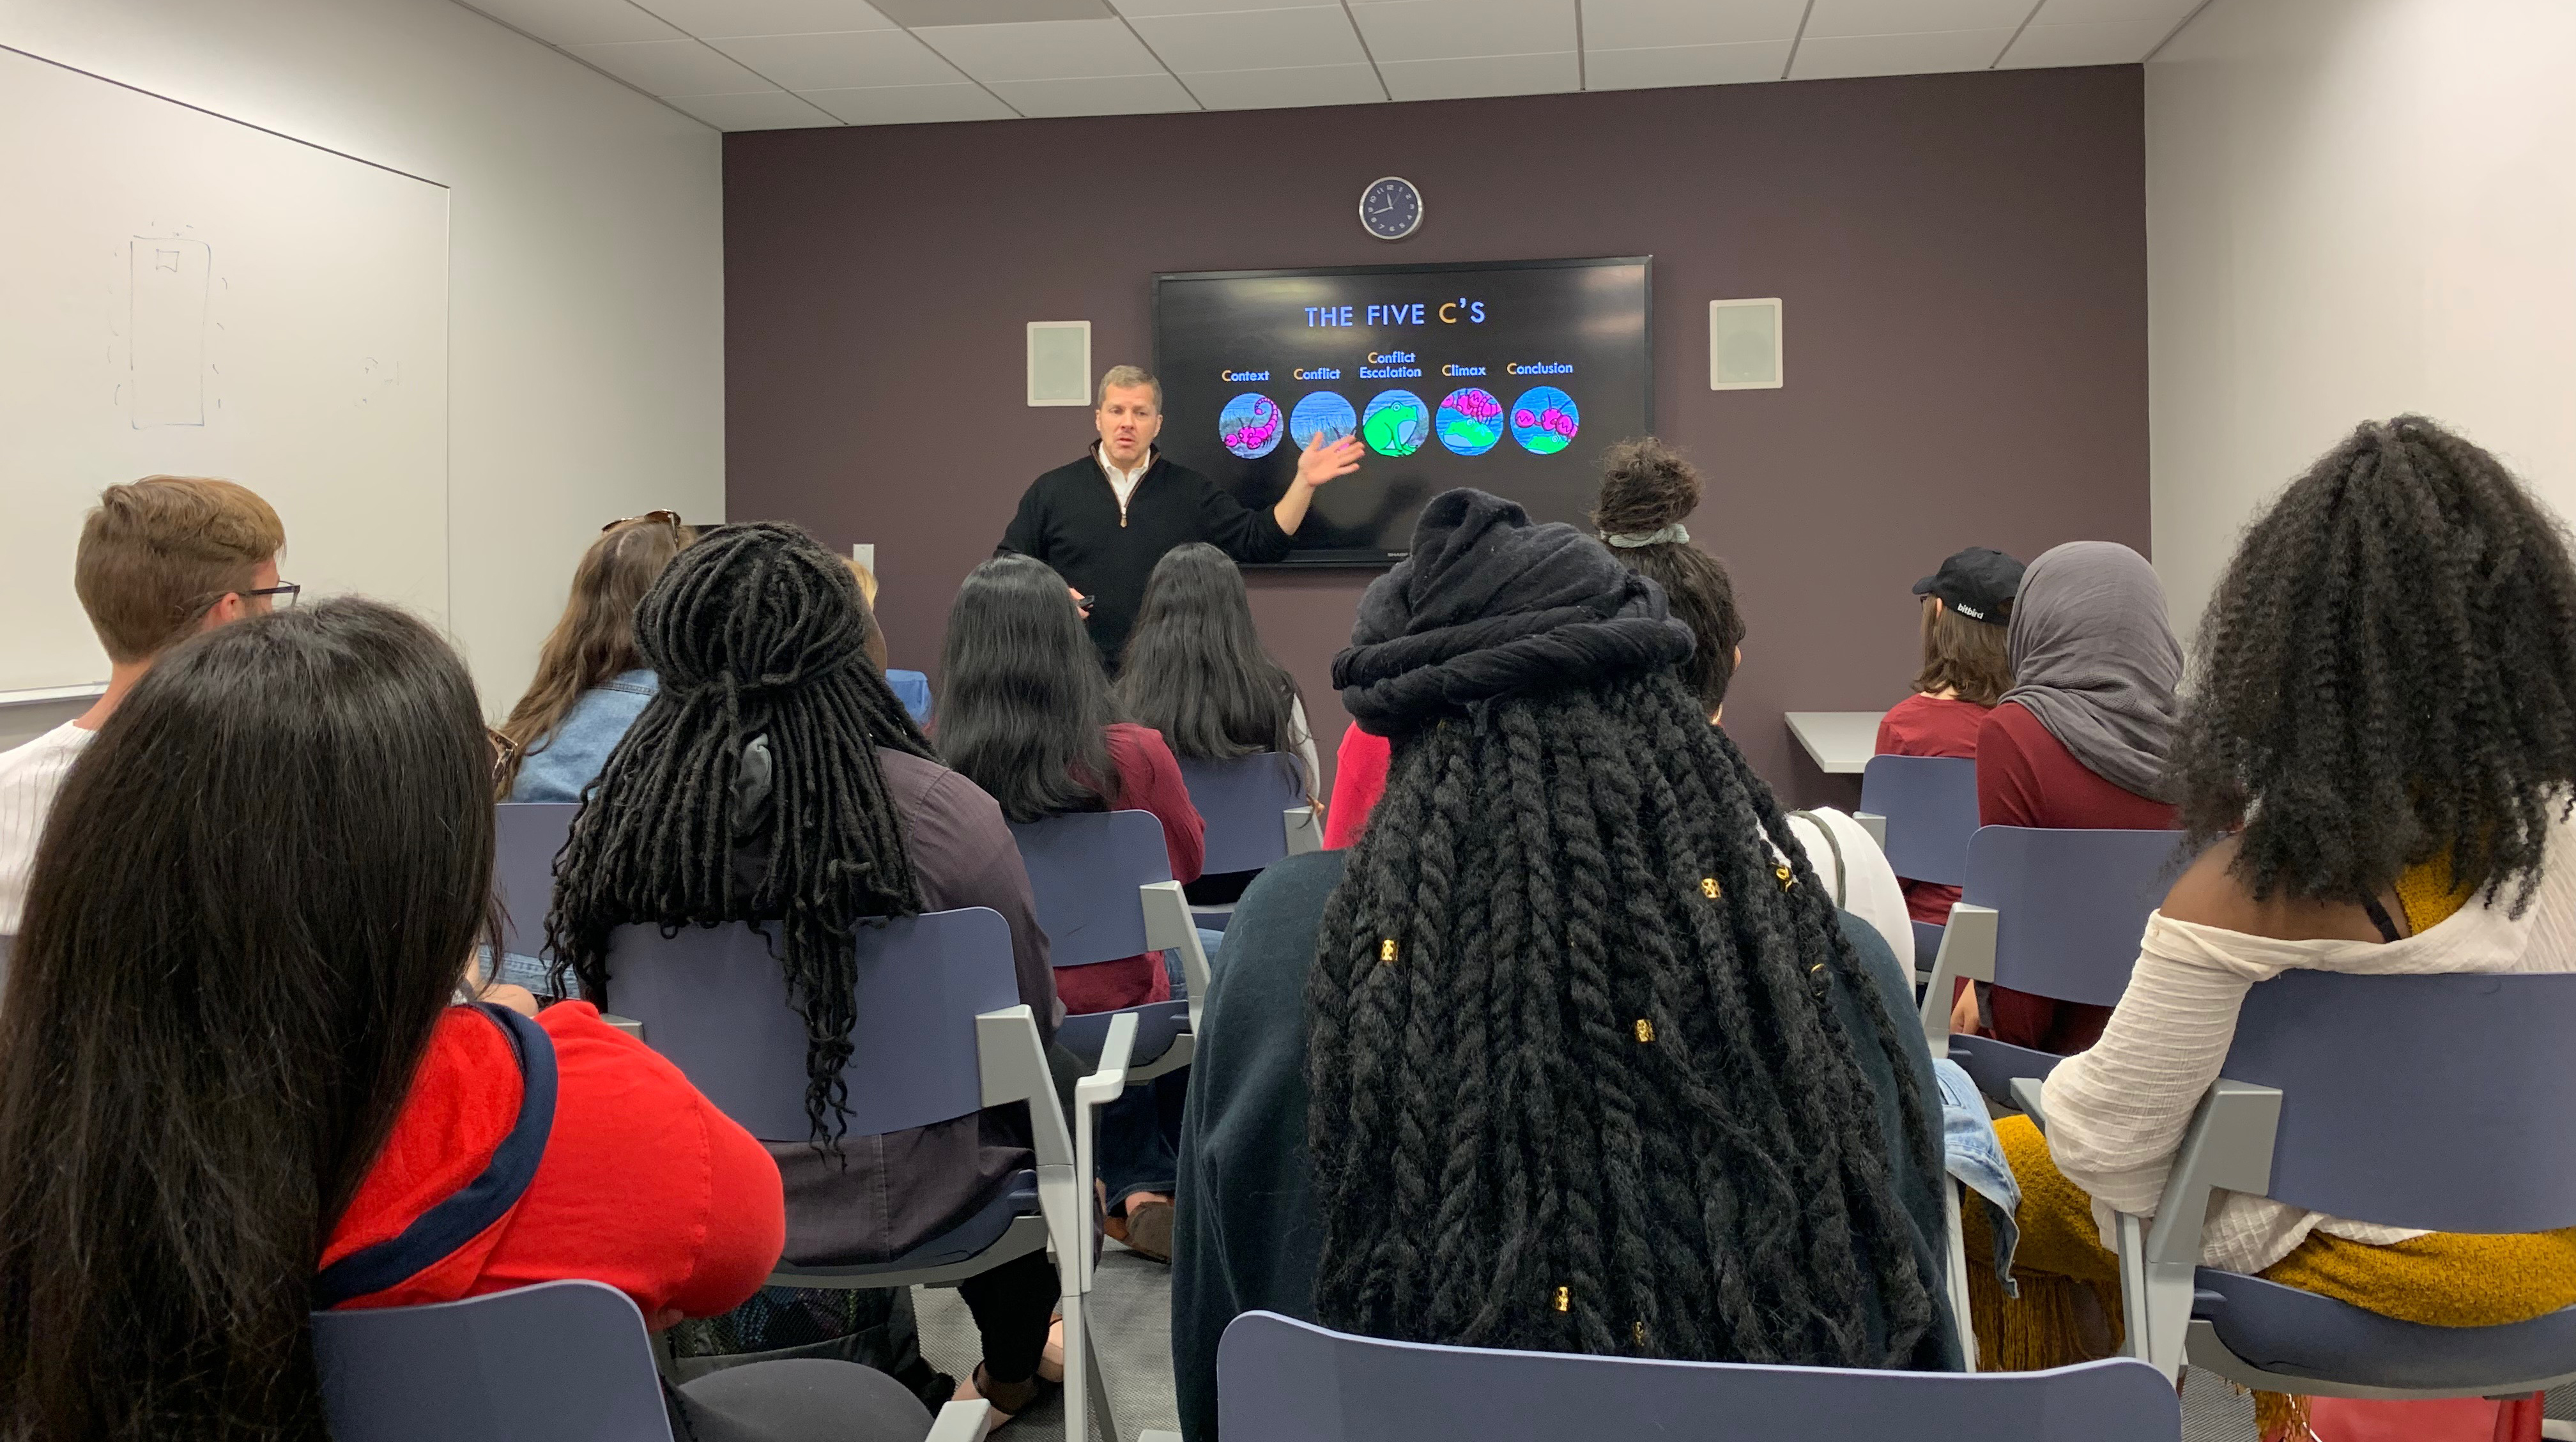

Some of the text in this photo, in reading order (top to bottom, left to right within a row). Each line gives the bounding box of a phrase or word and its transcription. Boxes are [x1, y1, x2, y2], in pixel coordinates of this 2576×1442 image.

[1305, 307, 1353, 327] THE
[1367, 303, 1425, 326] FIVE
[1368, 351, 1416, 365] Conflict
[1294, 367, 1342, 381] Conflict
[1360, 365, 1422, 379] Escalation
[1442, 364, 1487, 377] Climax
[1506, 361, 1574, 375] Conclusion
[1222, 369, 1270, 382] Context
[1957, 602, 1984, 620] bitbird
